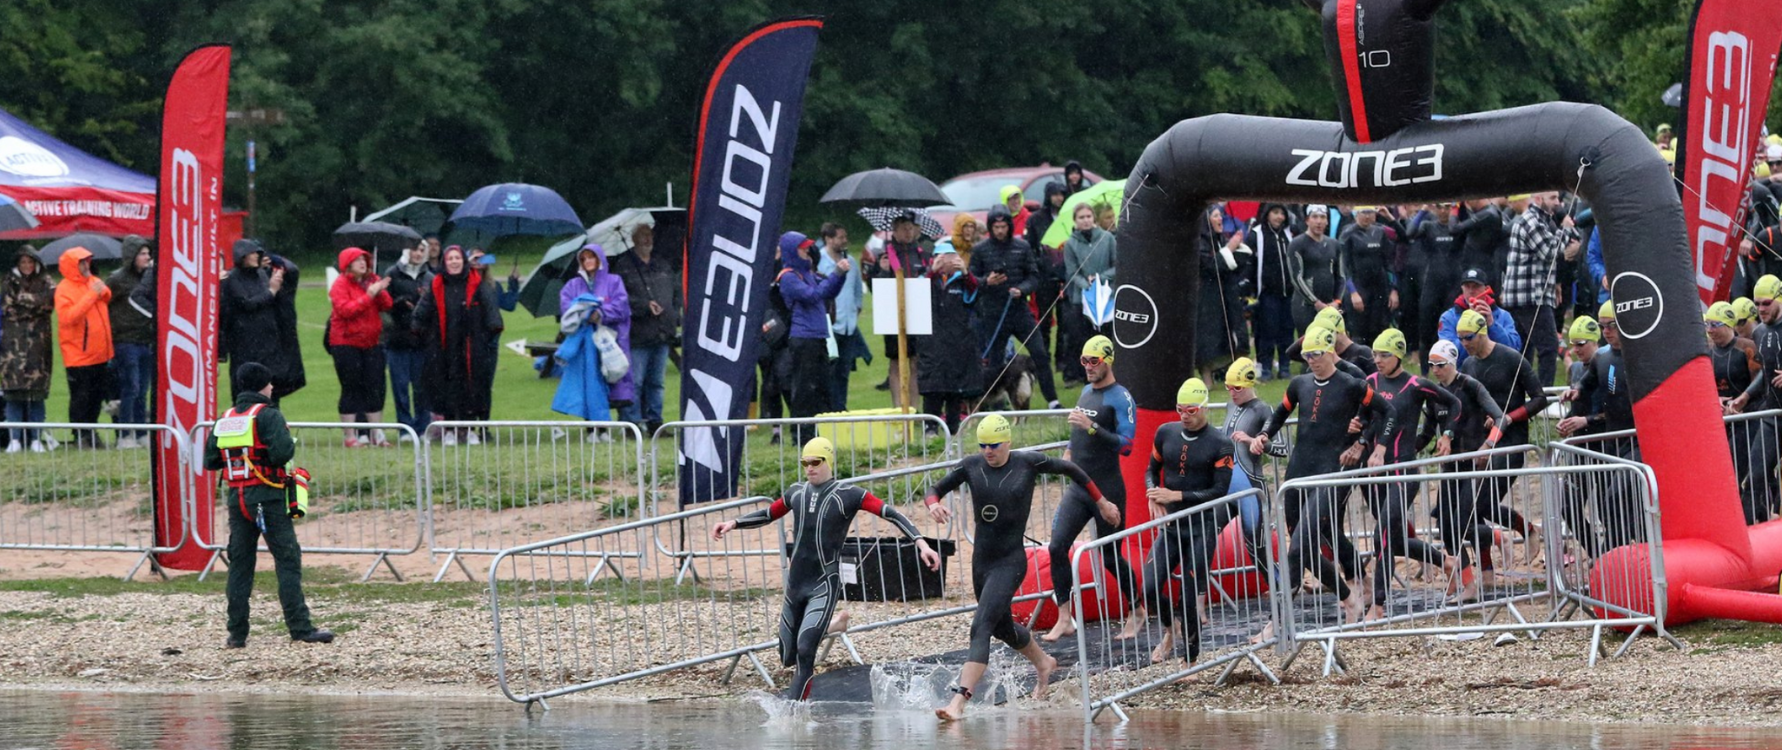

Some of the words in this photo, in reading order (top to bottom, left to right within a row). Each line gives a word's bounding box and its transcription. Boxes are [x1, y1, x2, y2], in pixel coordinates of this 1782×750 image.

[1358, 50, 1391, 68] 10
[1285, 143, 1444, 188] ZONE3
[1696, 31, 1748, 309] ONE3
[210, 176, 218, 201] IN
[24, 200, 62, 216] ACTIVE
[62, 201, 112, 217] TRAINING
[113, 203, 150, 220] WORLD
[697, 83, 781, 362] ZONE3
[210, 209, 218, 275] BUILT
[1115, 309, 1149, 324] ZONE3
[1616, 296, 1653, 314] ZONE3
